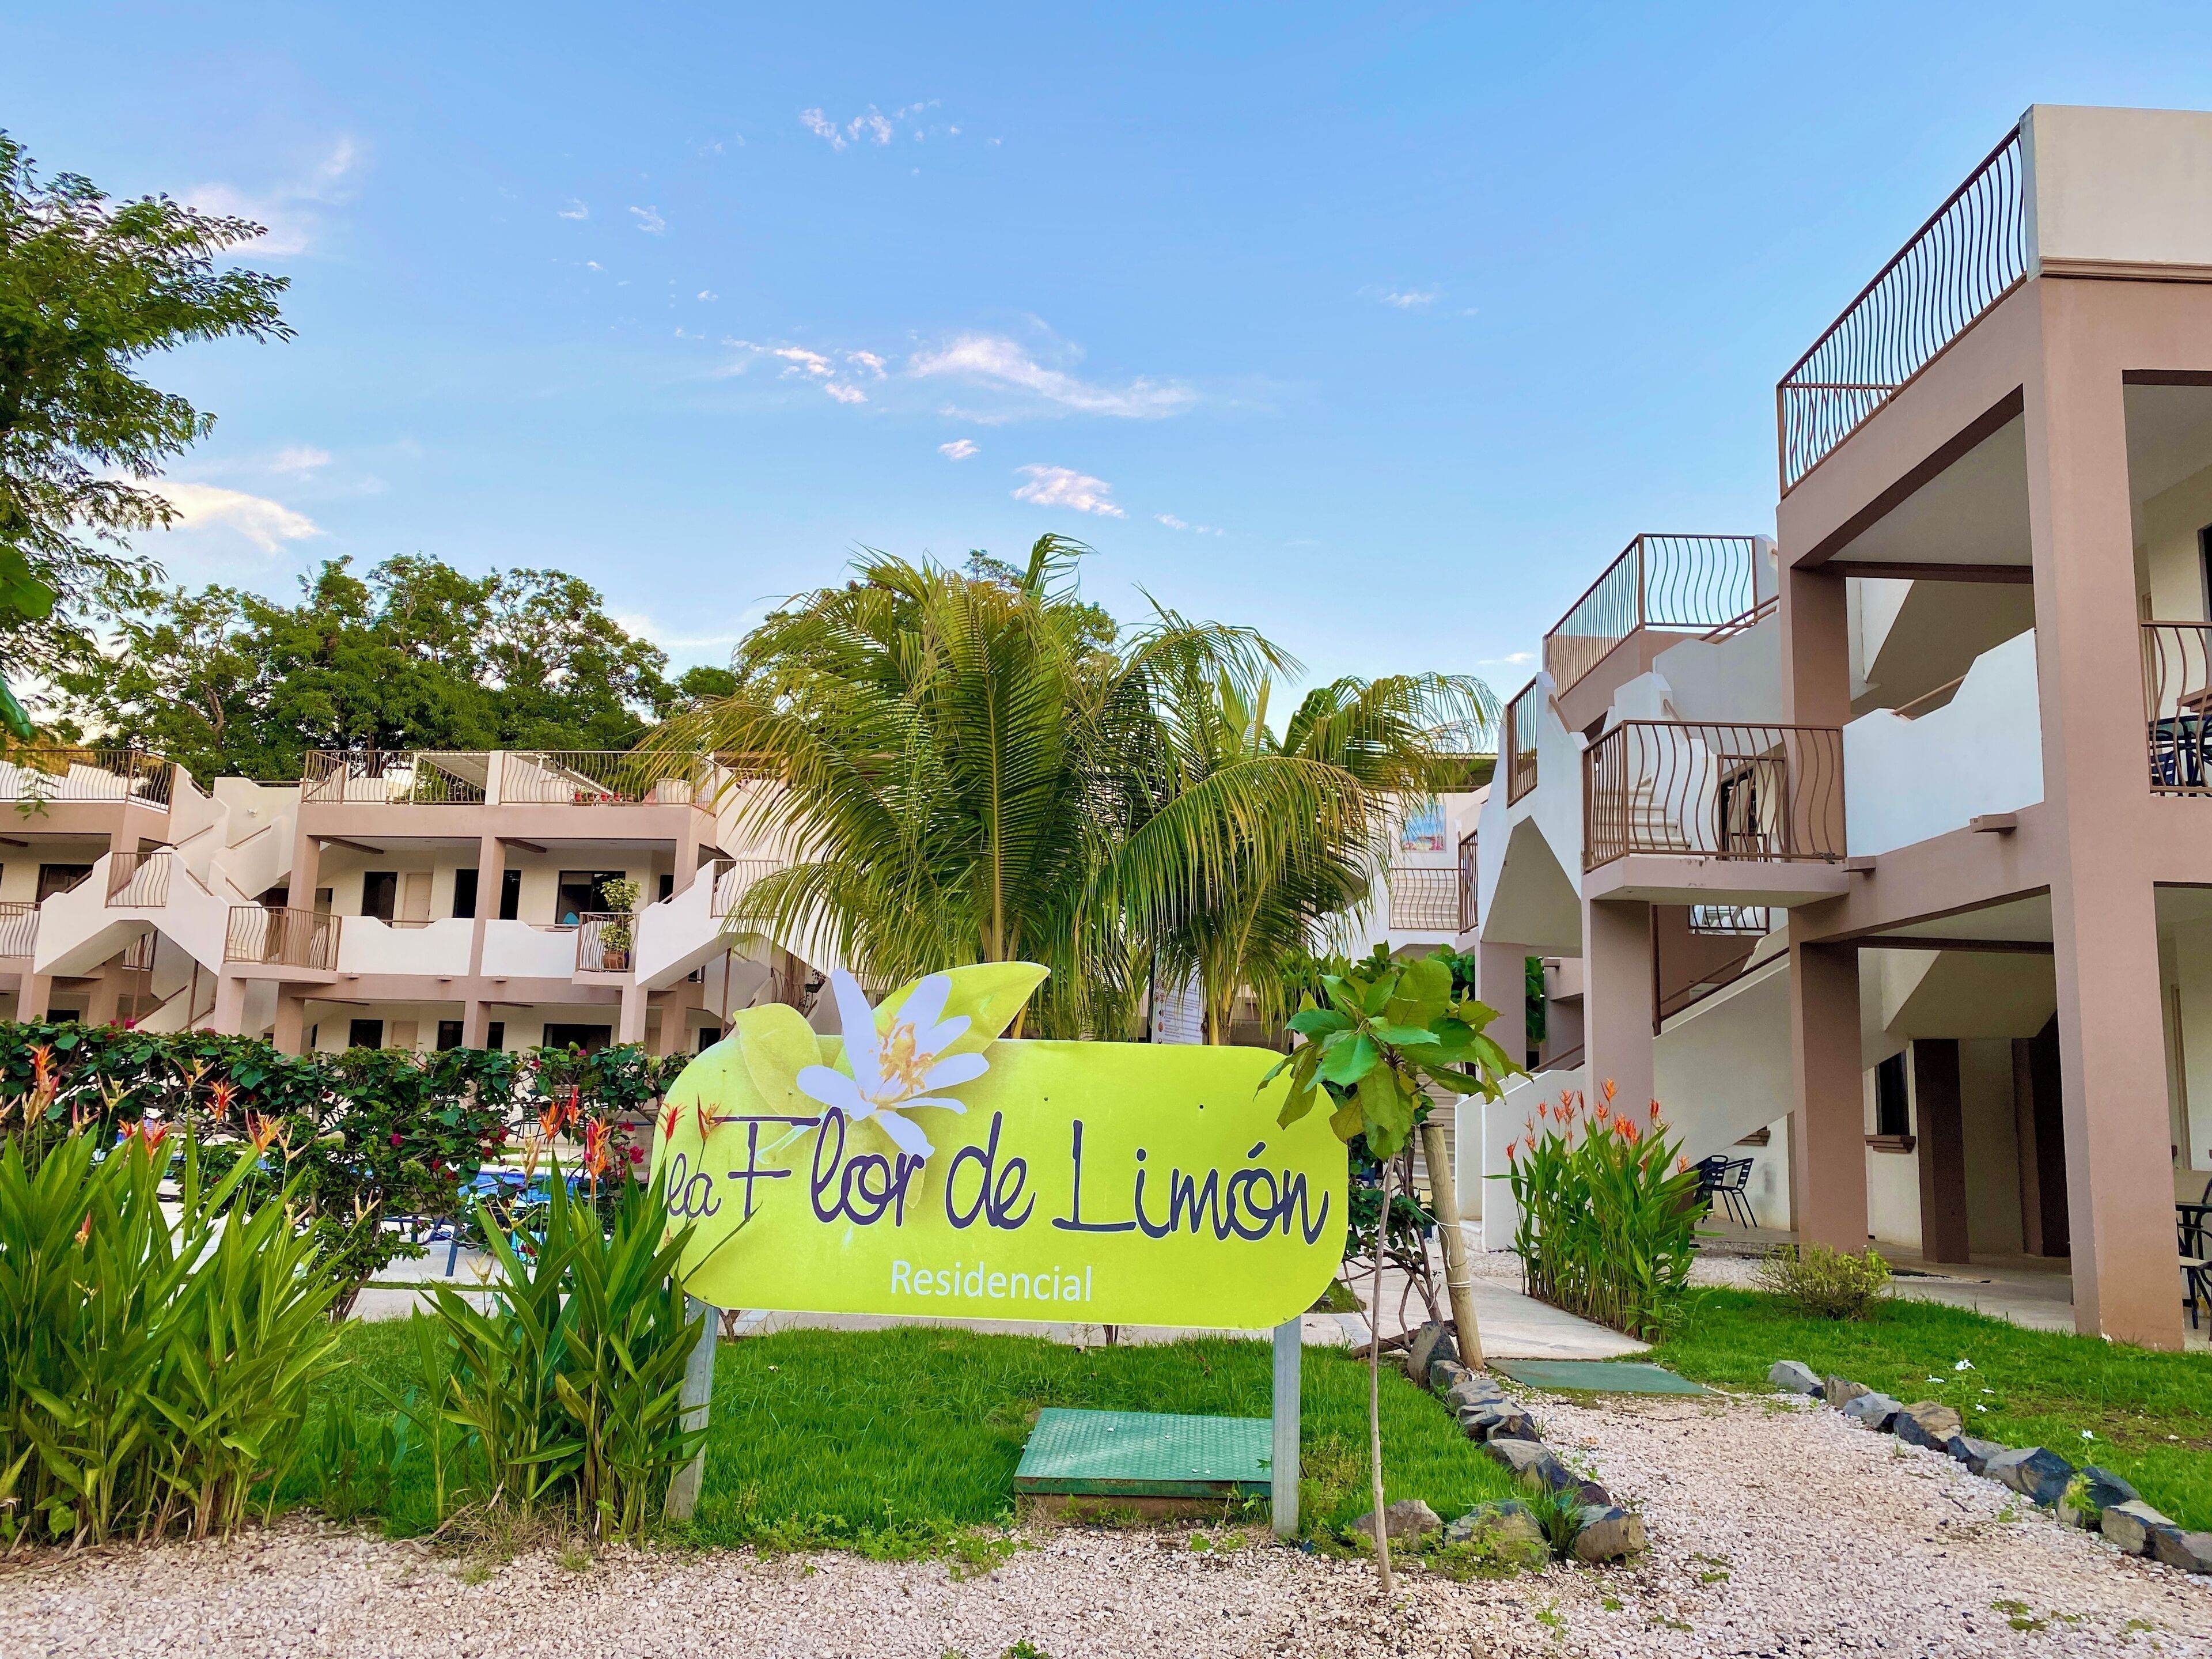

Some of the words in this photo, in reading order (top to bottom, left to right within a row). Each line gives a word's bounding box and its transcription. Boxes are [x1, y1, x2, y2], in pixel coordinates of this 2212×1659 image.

[668, 1153, 722, 1218] la
[711, 1107, 925, 1227] Flor
[946, 1111, 1036, 1229] de
[1052, 1119, 1328, 1245] Limón
[891, 1260, 1092, 1302] Residencial
